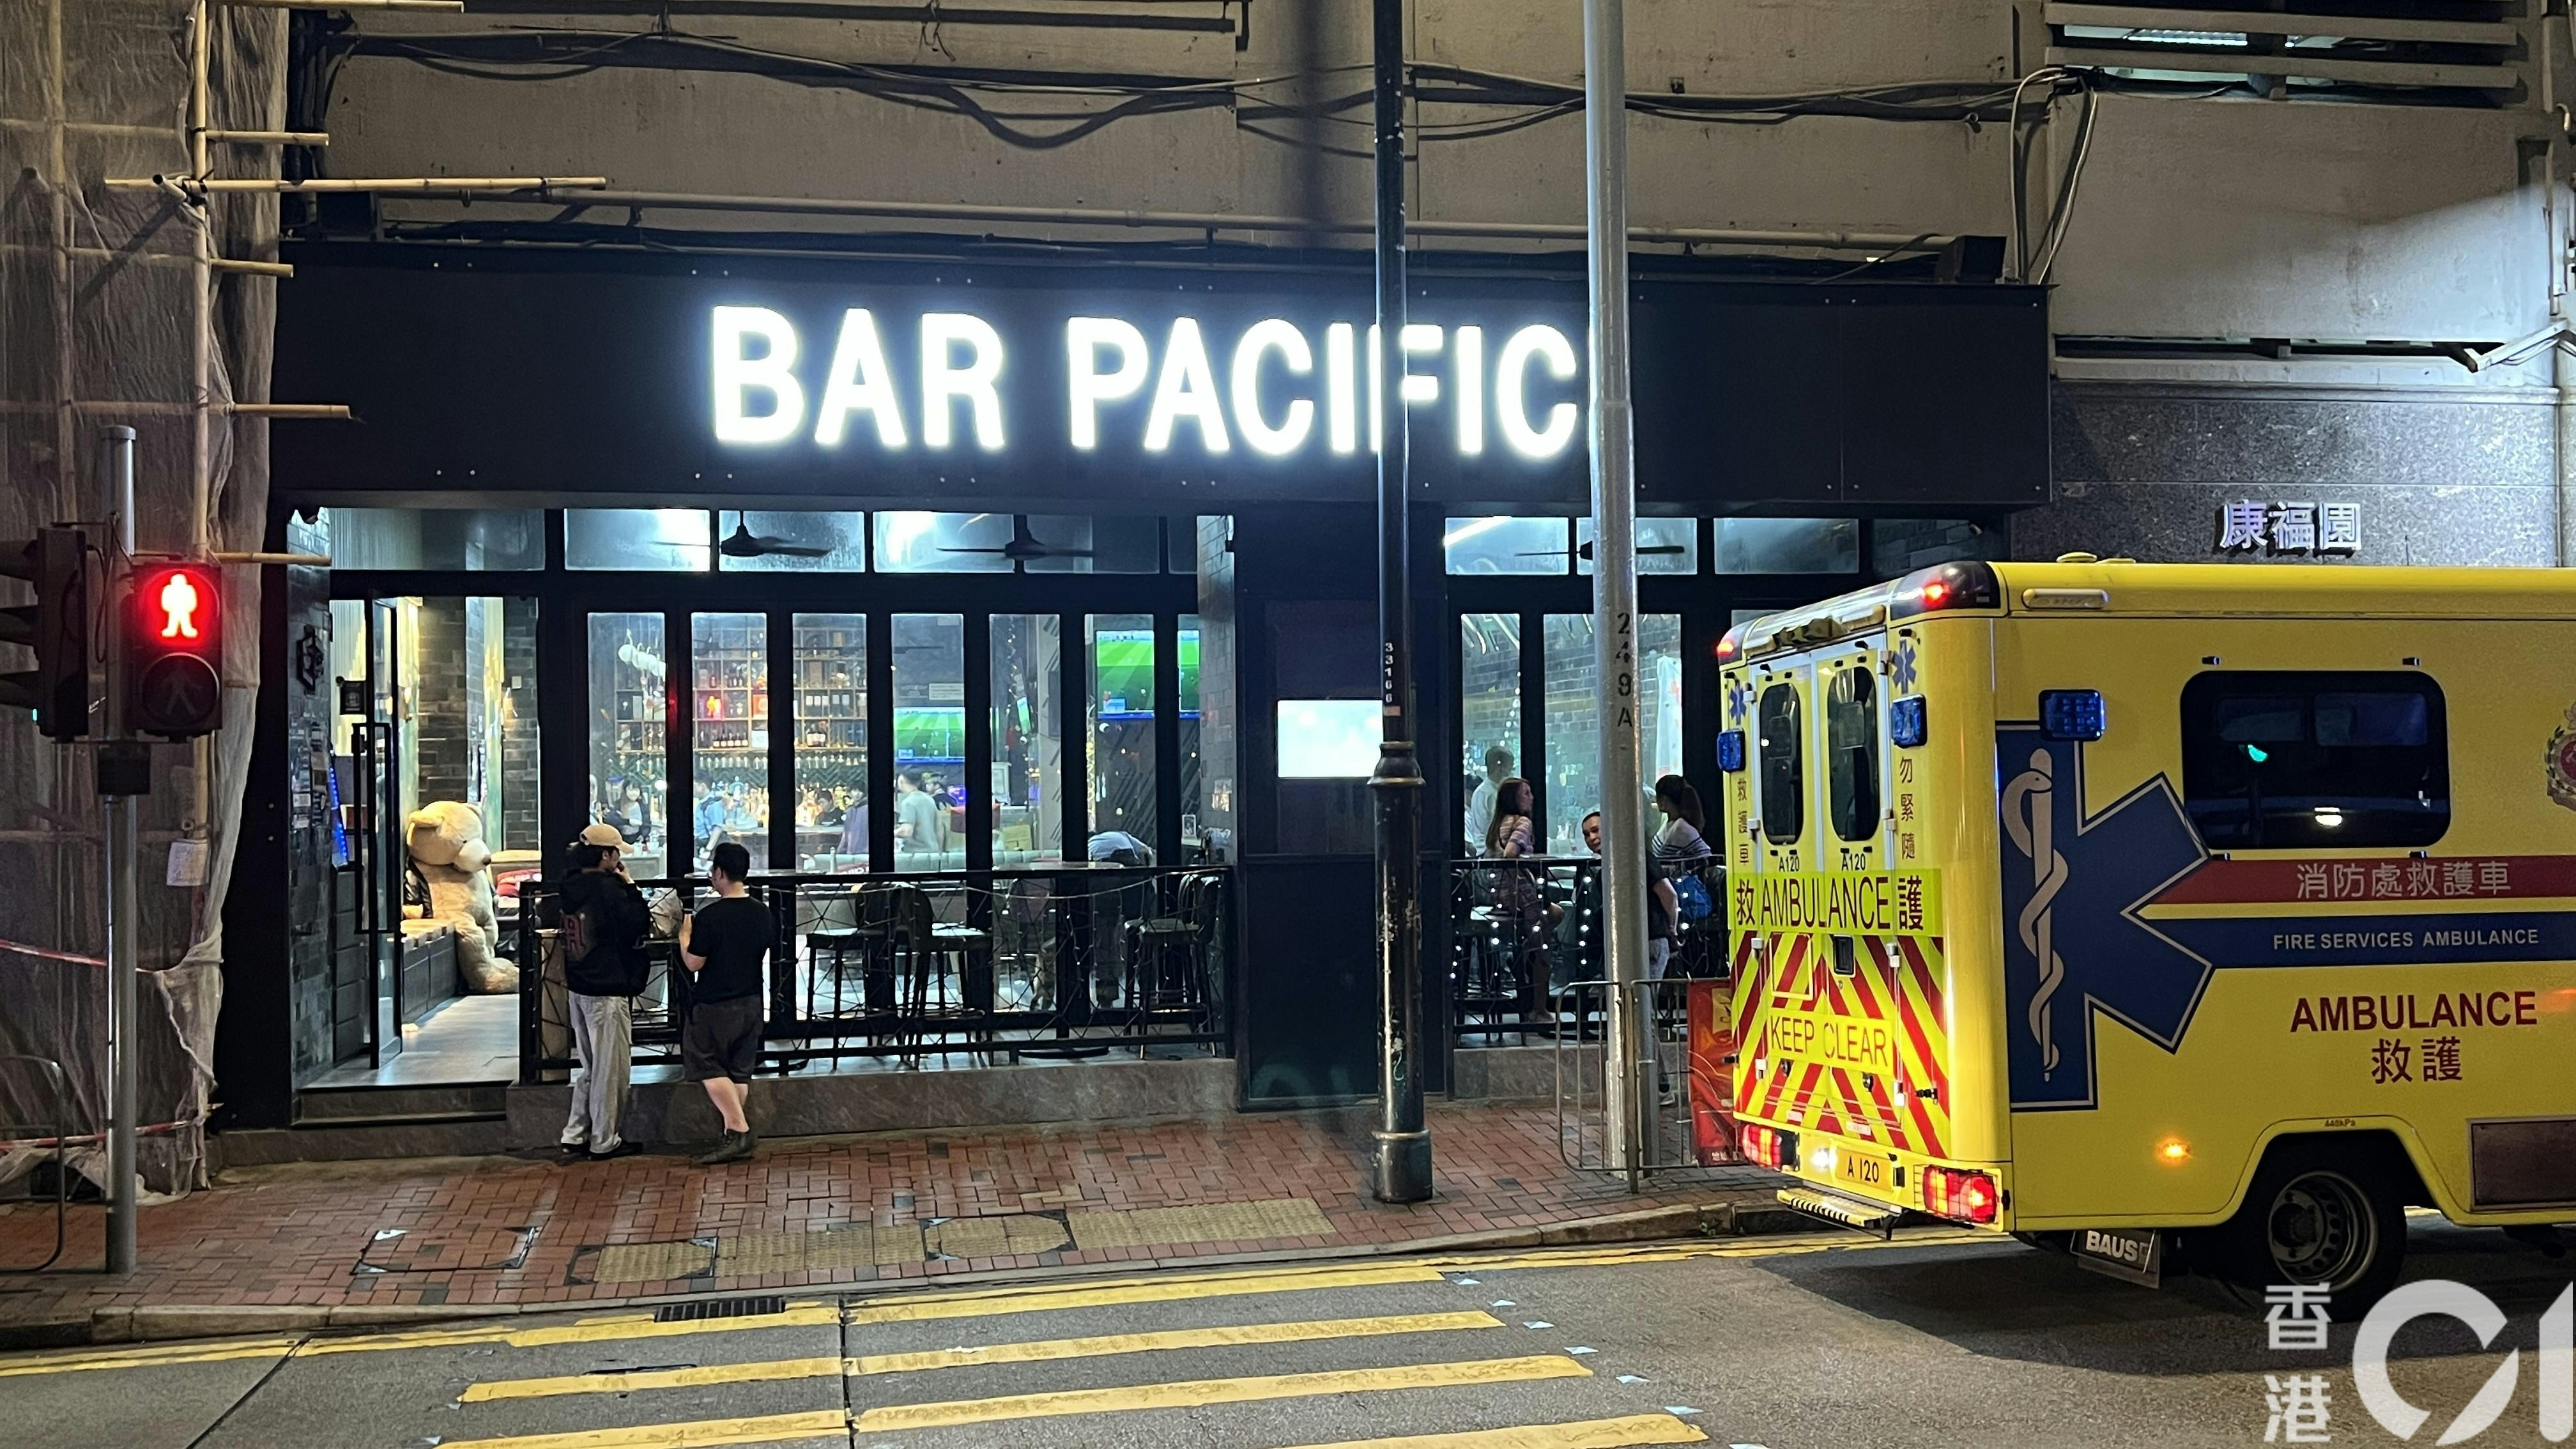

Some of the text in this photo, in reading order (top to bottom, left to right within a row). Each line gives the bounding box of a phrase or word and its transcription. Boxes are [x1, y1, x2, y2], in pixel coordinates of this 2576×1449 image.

[712, 305, 1578, 457] BAR PACIFIC
[2220, 500, 2361, 550] 康福園
[1384, 642, 1393, 703] 33166
[1899, 756, 1915, 860] 勿緊隨
[1778, 856, 1800, 873] A120
[1841, 853, 1866, 871] A120
[2297, 861, 2511, 899] 消防處救護車
[1761, 877, 1891, 930] AMBULANCE
[2273, 929, 2539, 950] FIRE SERVICES AMBULANCE
[2290, 991, 2538, 1033] AMBULANCE
[1770, 1015, 1888, 1068] KEEP CLEAR
[2371, 1036, 2462, 1084] 救護
[1847, 1156, 1880, 1183] A 120
